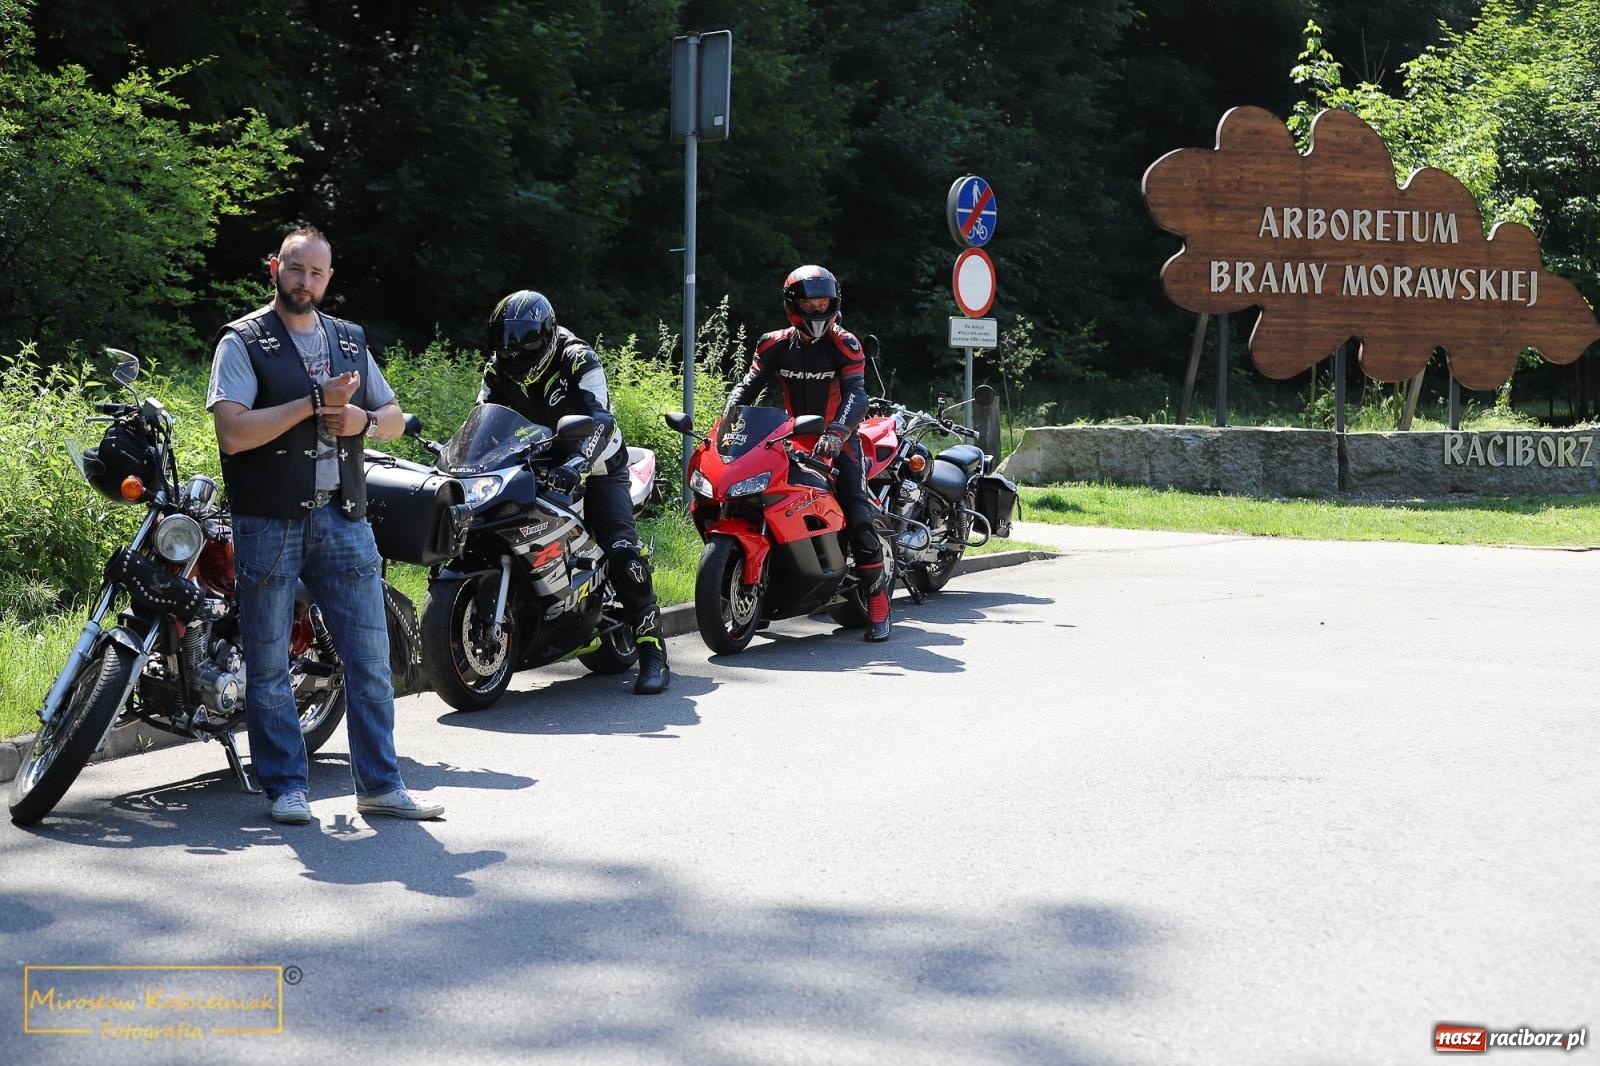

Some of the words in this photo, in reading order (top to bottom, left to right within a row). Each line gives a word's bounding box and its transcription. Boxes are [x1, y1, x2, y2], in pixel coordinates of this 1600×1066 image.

[1258, 206, 1459, 245] ARBORETUM
[1210, 260, 1328, 295] BRAMY
[1342, 264, 1539, 307] MORAWSKIEJ
[779, 368, 836, 380] SHIMA
[838, 392, 856, 425] SHIMA
[1444, 433, 1594, 468] RACIBORZ
